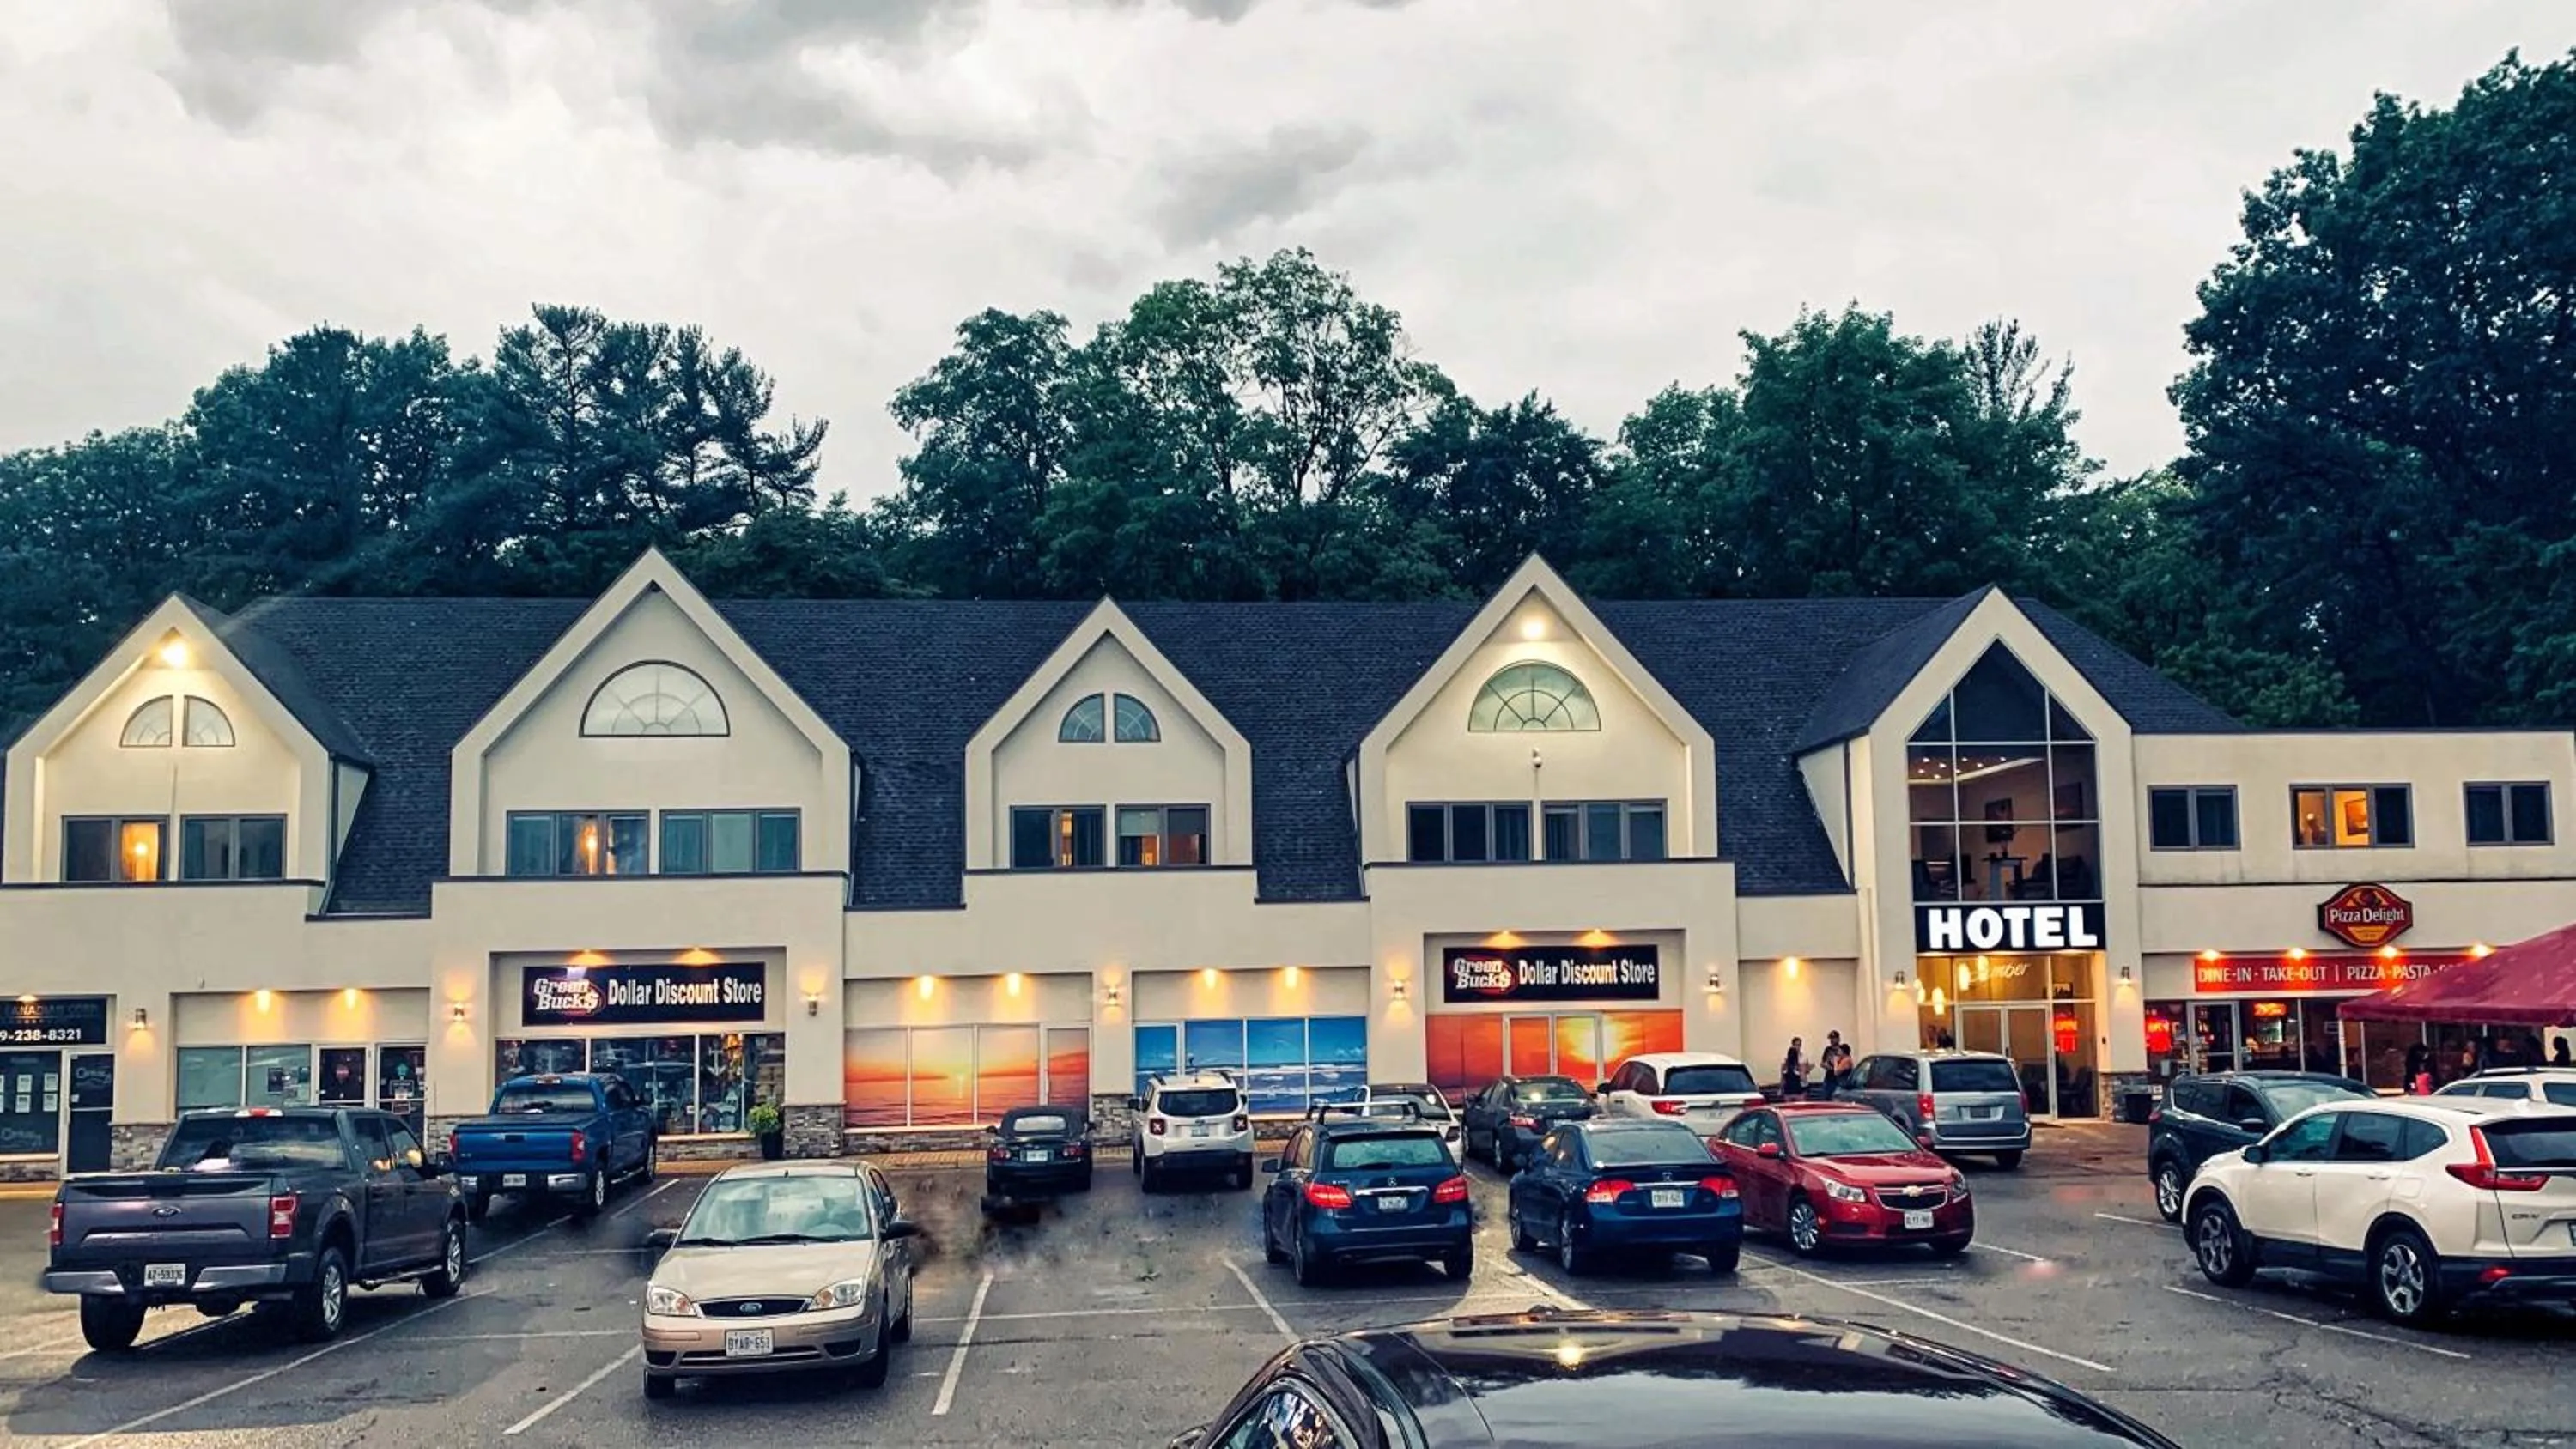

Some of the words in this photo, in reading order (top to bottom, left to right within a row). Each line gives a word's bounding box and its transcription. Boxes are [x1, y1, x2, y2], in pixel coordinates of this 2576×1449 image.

[2330, 908, 2360, 923] Pizza
[2362, 907, 2405, 925] Delight
[1928, 906, 2098, 949] HOTEL
[1454, 958, 1502, 973] Green
[1518, 959, 1558, 985] Dollar
[1561, 959, 1618, 985] Discount
[1620, 958, 1656, 983] Store
[2197, 967, 2252, 983] DINE-IN
[2261, 966, 2327, 981] TAKE-OUT
[2347, 965, 2386, 980] PIZZA
[2391, 964, 2431, 979] PASTA
[607, 978, 652, 1005] Dollar
[655, 978, 720, 1005] Discount
[723, 976, 762, 1003] Store
[0, 1028, 82, 1041] 9-238-8321
